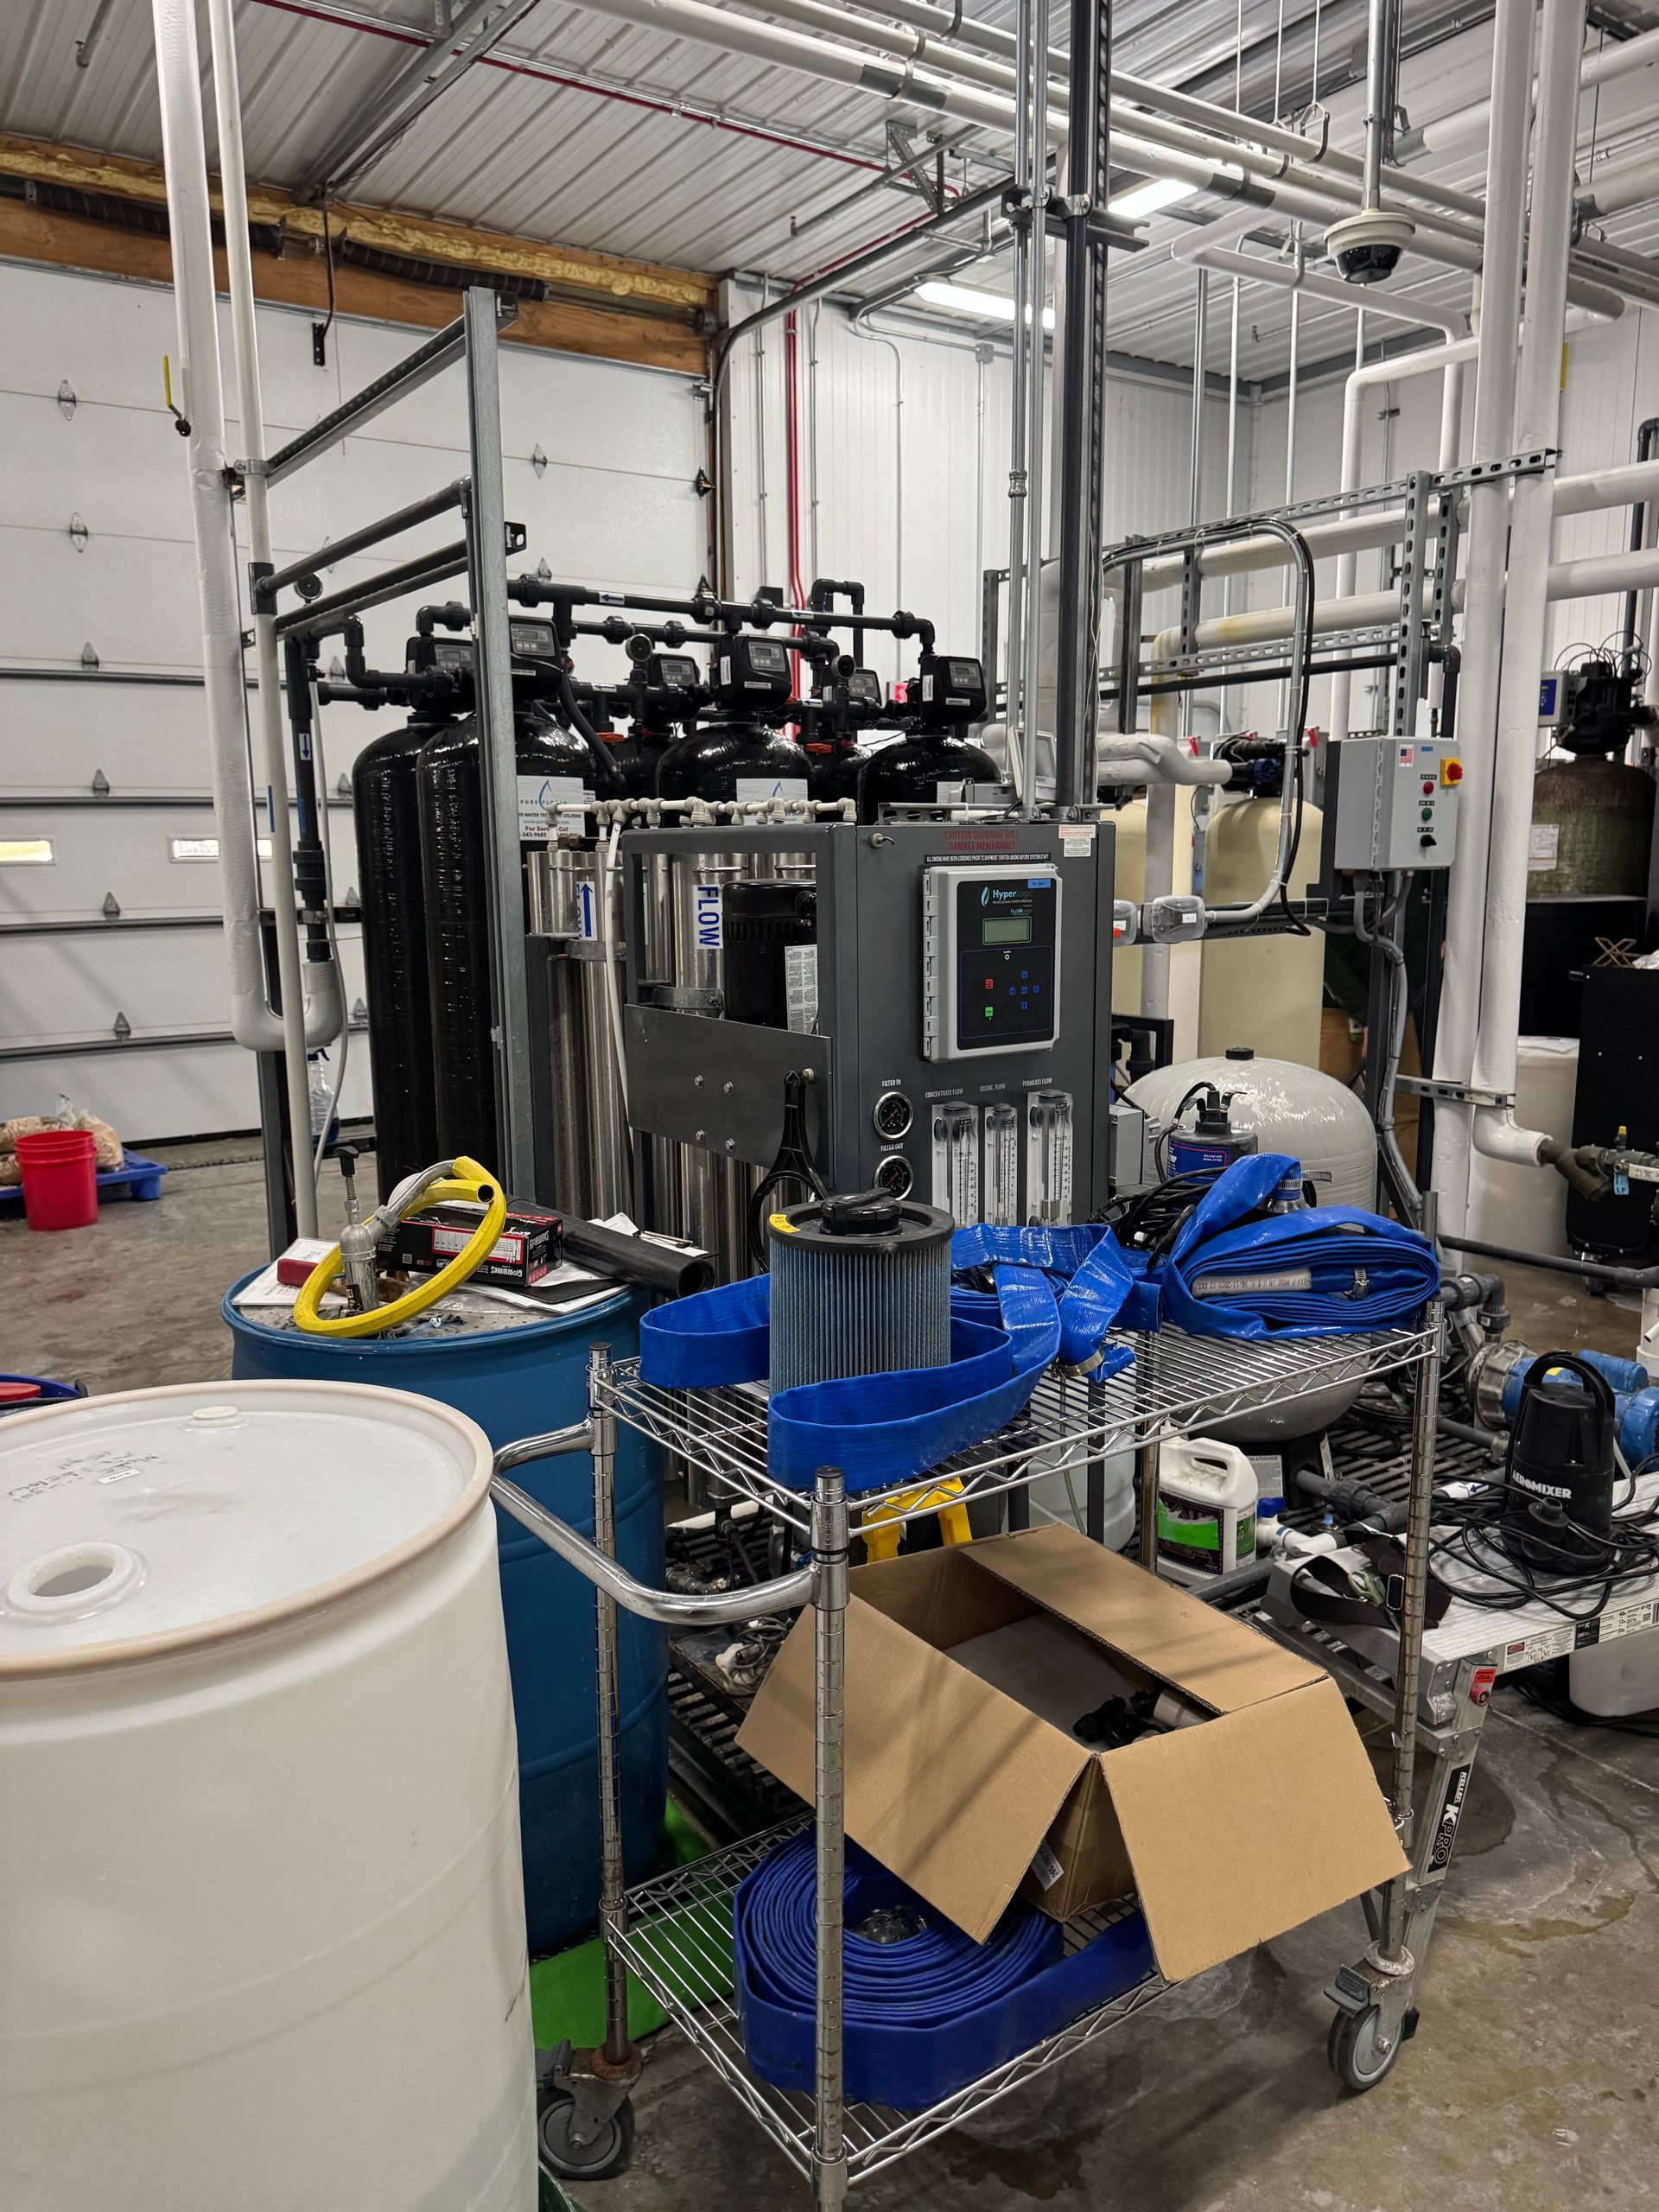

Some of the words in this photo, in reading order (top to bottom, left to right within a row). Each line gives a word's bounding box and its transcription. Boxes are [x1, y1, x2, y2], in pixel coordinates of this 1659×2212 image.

[944, 831, 972, 840] CAUTION
[974, 830, 1003, 839] CHLORINE
[1004, 830, 1020, 838] WILL
[949, 842, 976, 851] DAMAGE
[976, 841, 1016, 850] MEMBRANES
[697, 887, 720, 946] FLOW
[1022, 1078, 1041, 1087] PERMEATE
[925, 1090, 952, 1098] CONCENTRATE
[1512, 1470, 1572, 1499] AEROMIXER
[1453, 1771, 1467, 1804] KELLER
